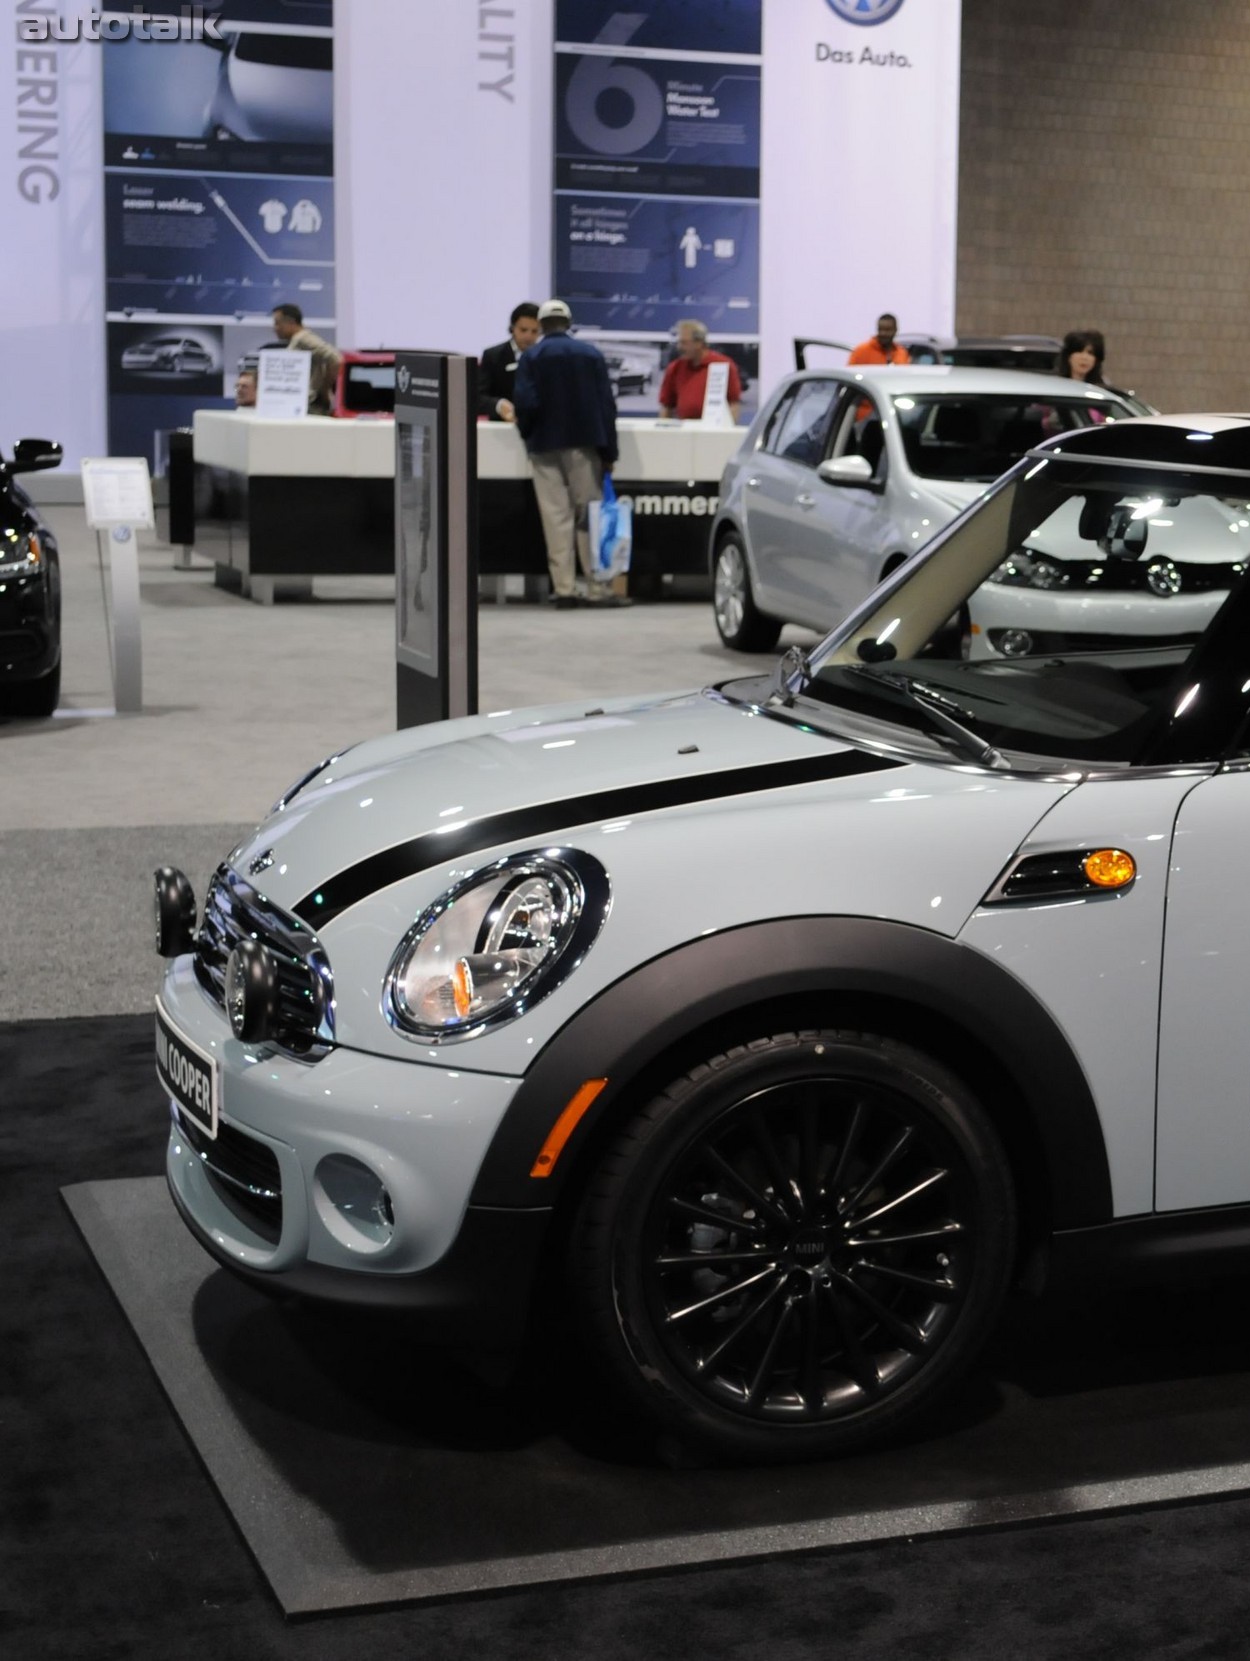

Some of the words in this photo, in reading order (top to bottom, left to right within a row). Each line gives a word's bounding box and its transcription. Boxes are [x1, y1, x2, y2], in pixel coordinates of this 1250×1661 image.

[478, 0, 514, 104] LITY
[816, 42, 854, 63] Das
[859, 46, 912, 68] Auto.
[17, 0, 60, 203] ERING
[168, 1042, 212, 1116] COOPER
[795, 1241, 825, 1255] MINI
